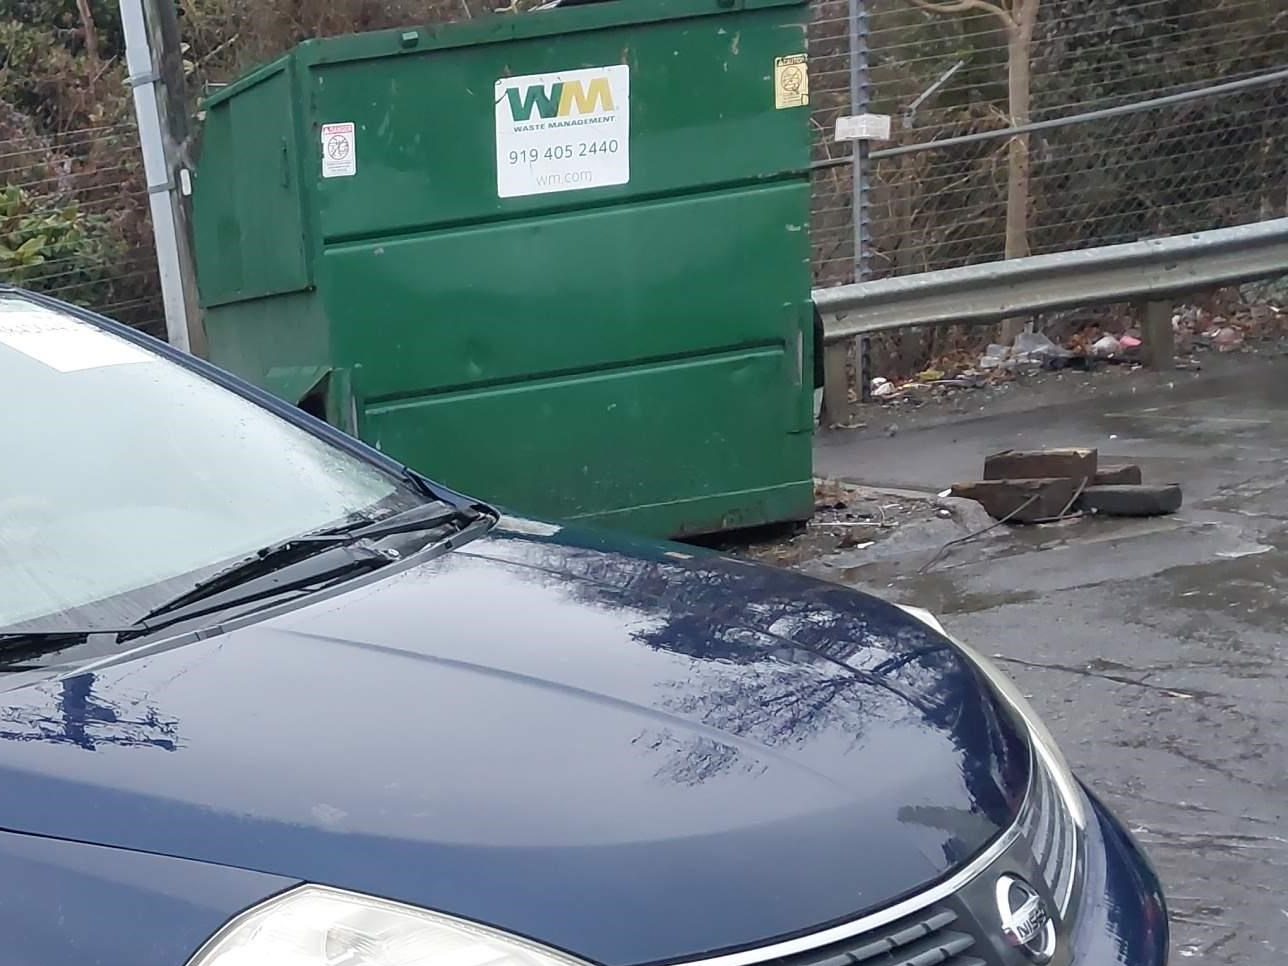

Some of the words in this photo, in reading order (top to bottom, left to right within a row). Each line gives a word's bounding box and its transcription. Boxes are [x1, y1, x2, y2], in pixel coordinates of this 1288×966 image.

[506, 77, 615, 122] WM
[513, 123, 545, 133] WASTE
[548, 115, 615, 129] MANAGEMENT
[509, 148, 539, 165] 919
[543, 144, 573, 160] 405
[578, 139, 619, 157] 2440
[536, 170, 593, 186] wm.com
